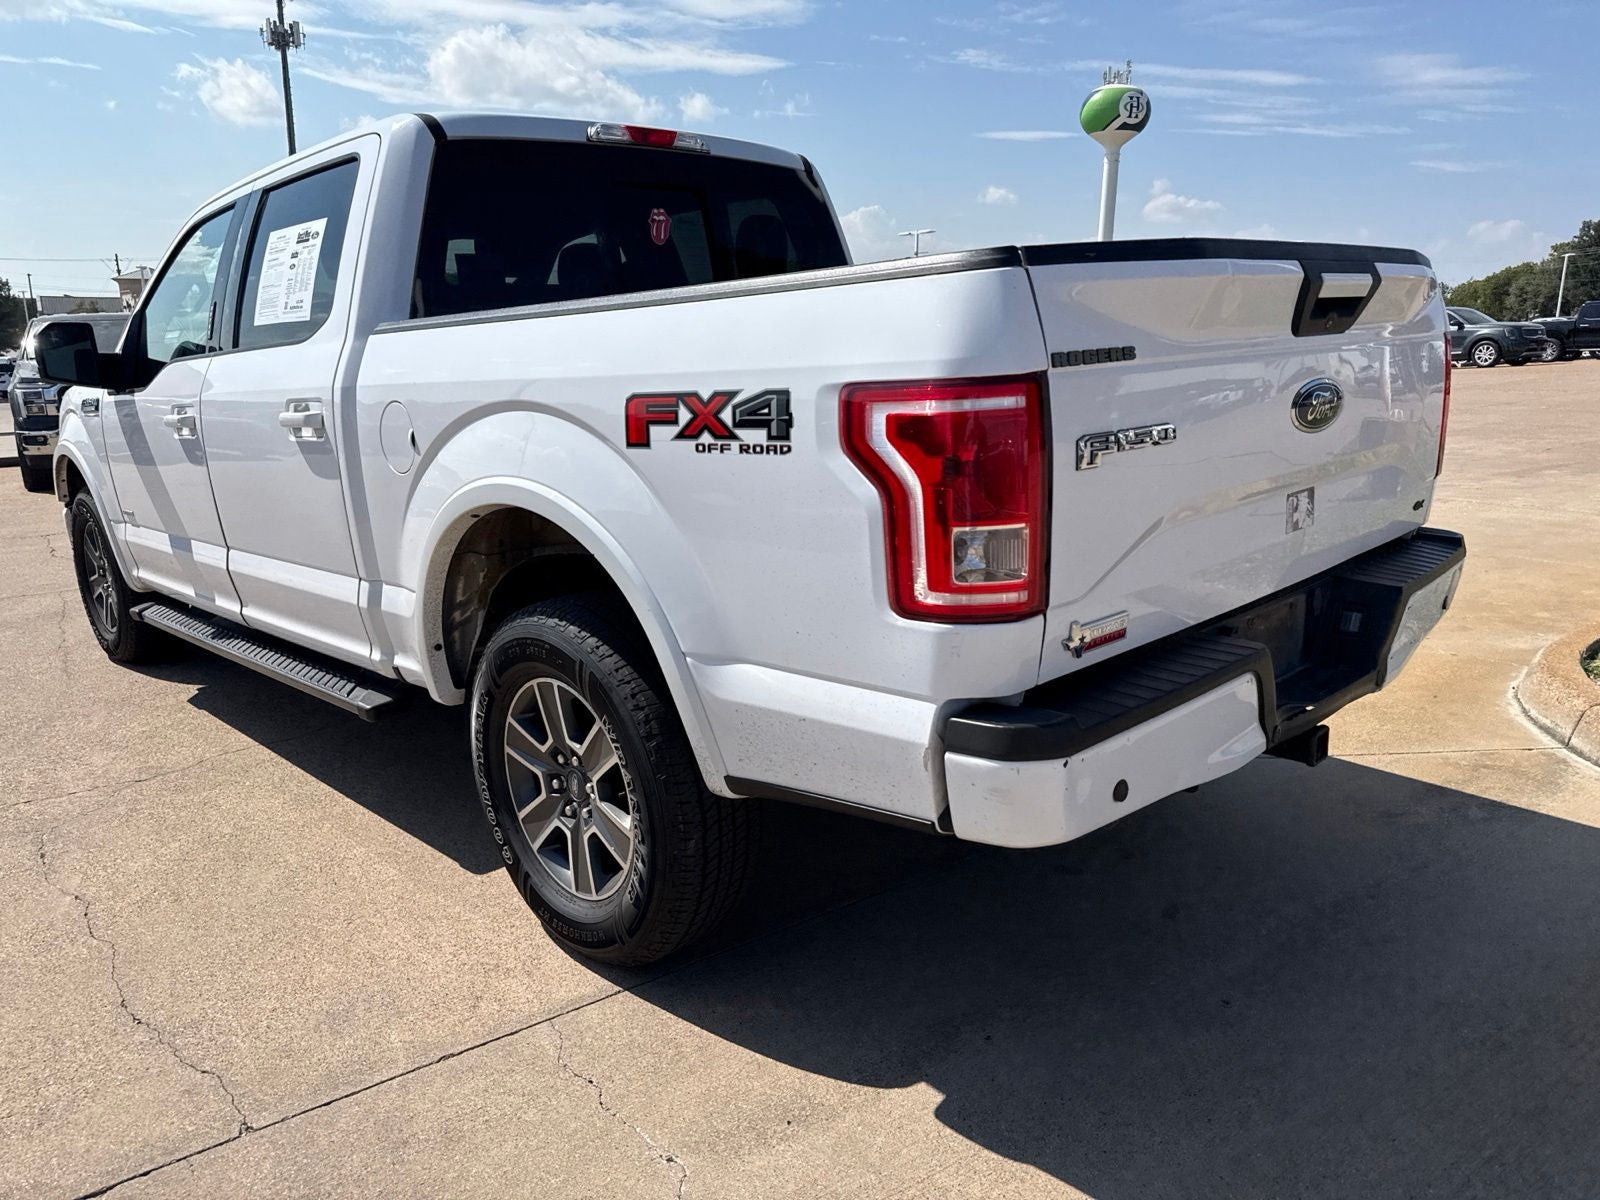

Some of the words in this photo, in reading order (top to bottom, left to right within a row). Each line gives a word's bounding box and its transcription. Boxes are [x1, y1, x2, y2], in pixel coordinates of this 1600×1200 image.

[1051, 346, 1137, 368] ROGERS
[625, 388, 794, 449] FX4
[694, 442, 732, 455] OFF
[738, 443, 792, 456] ROAD
